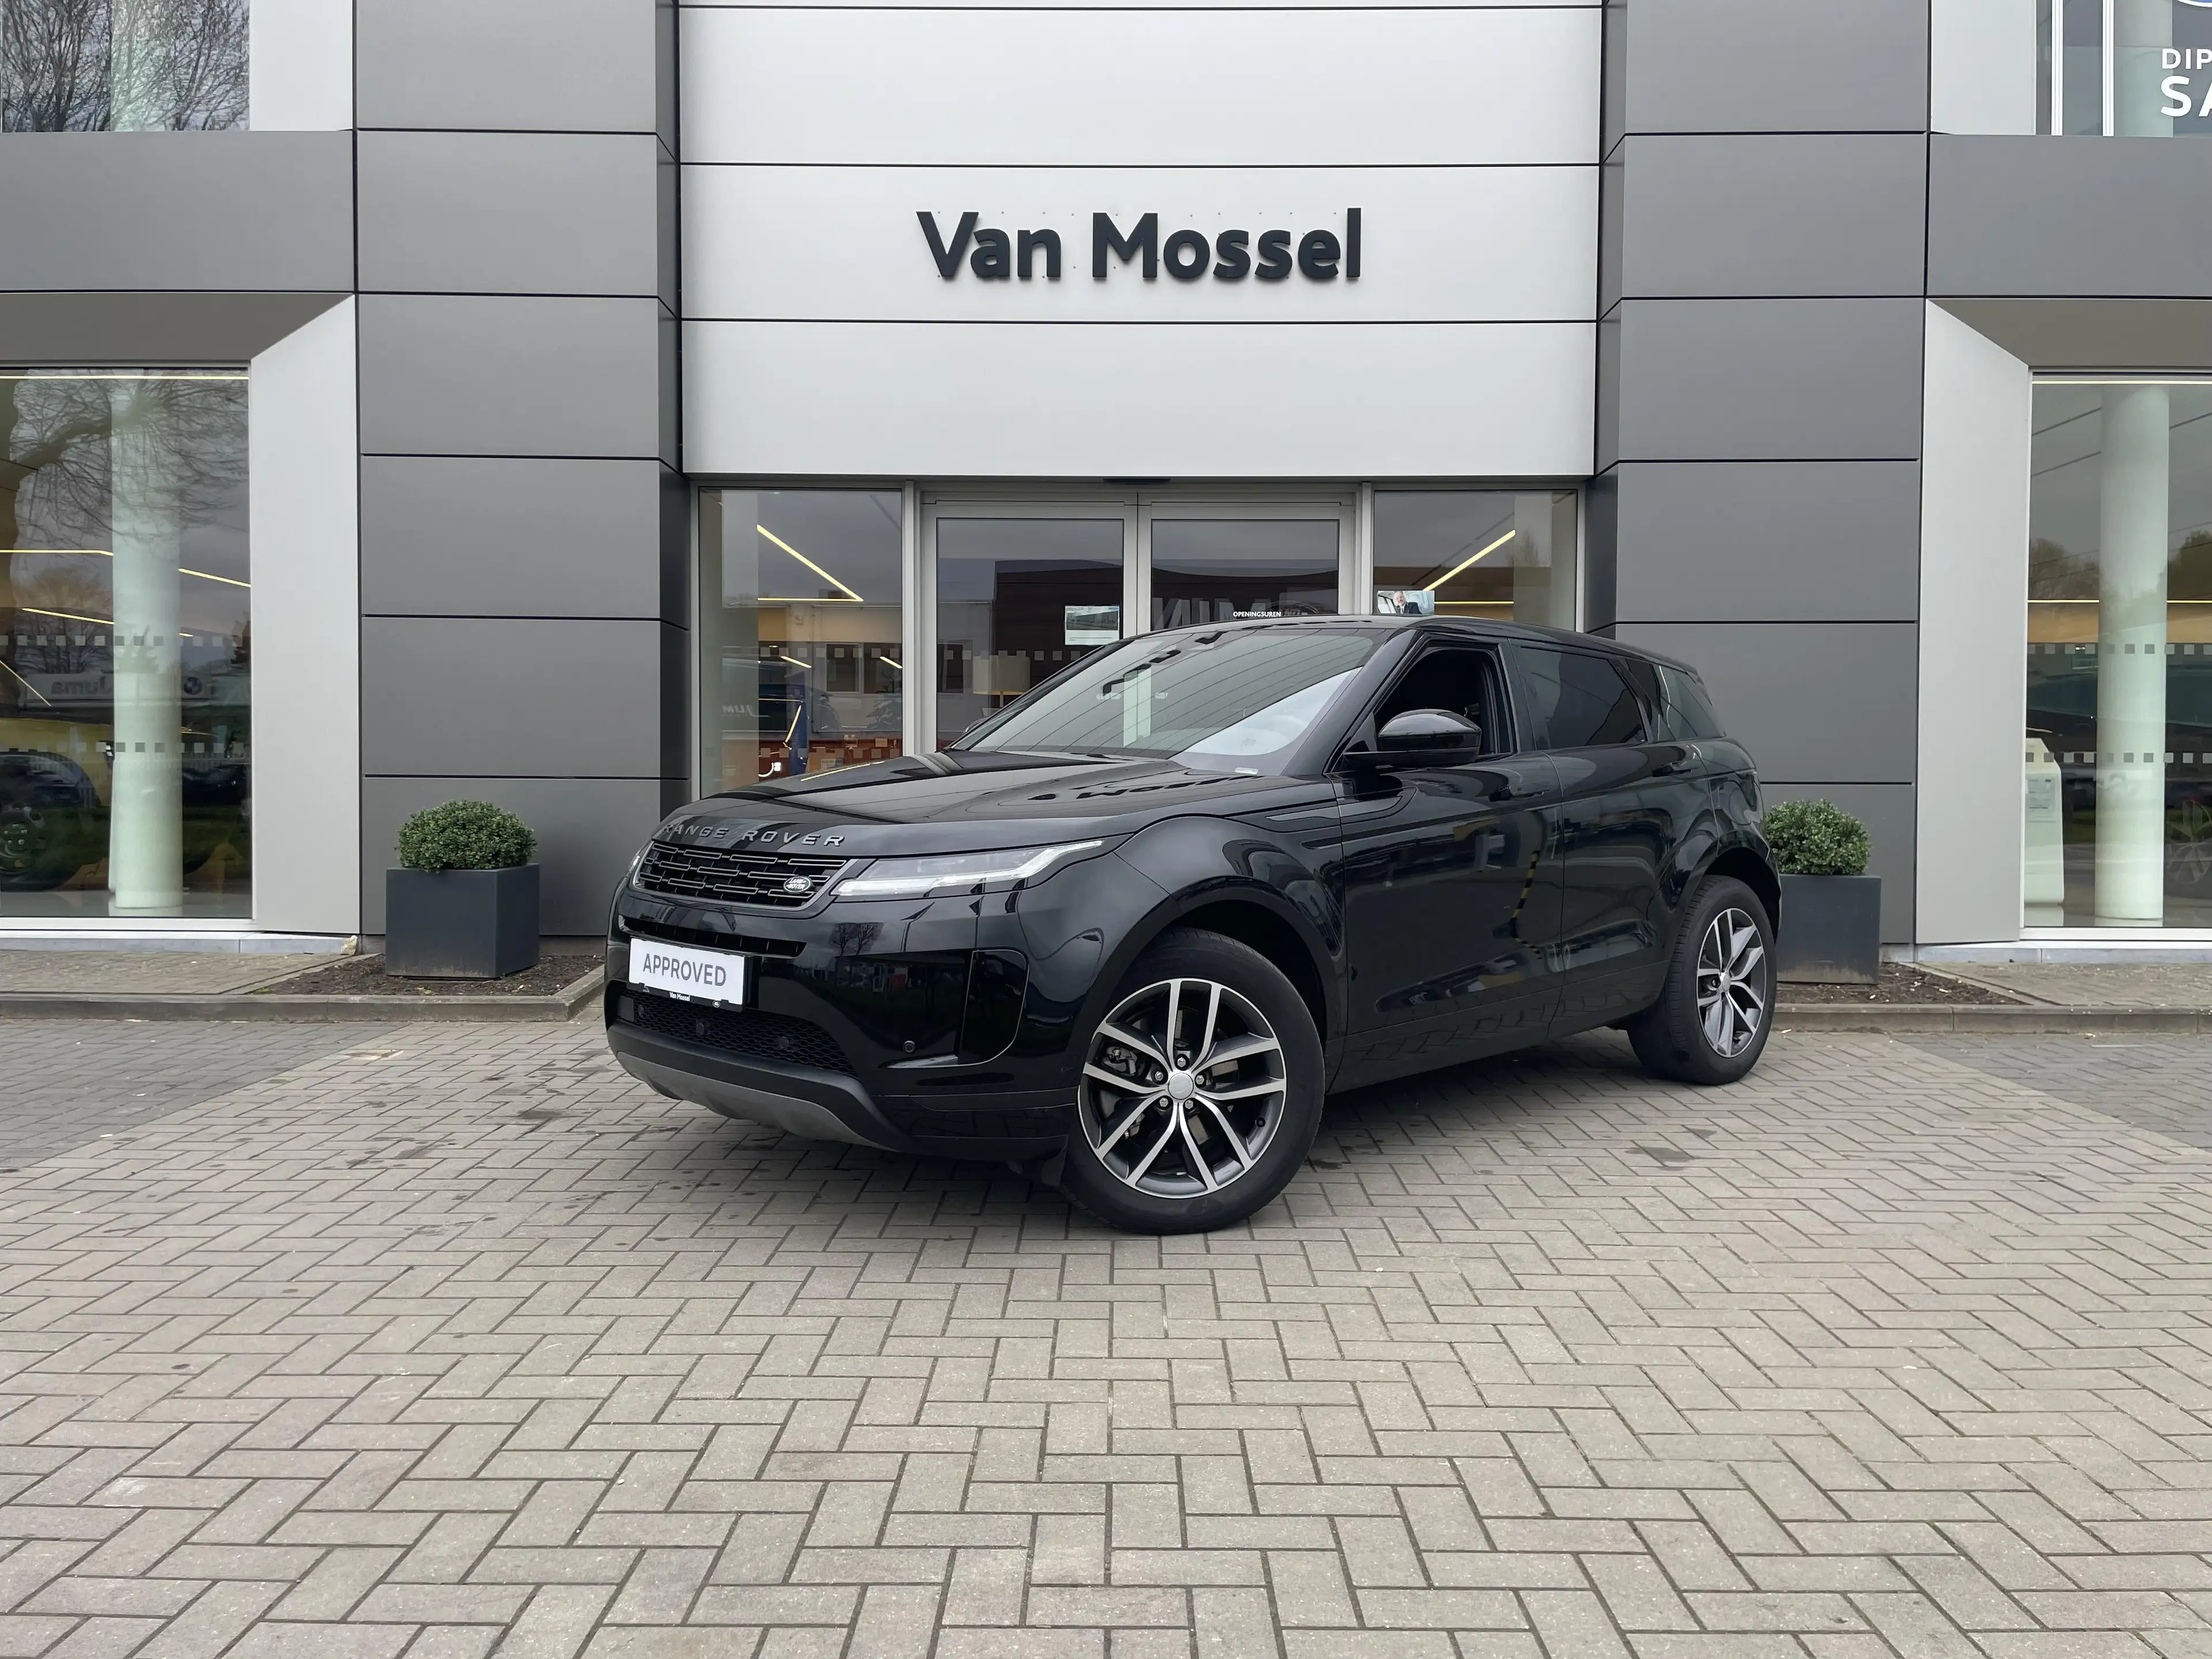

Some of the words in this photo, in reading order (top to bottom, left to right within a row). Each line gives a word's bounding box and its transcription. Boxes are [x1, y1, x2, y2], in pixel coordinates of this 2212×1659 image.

[915, 211, 1062, 281] Van
[1092, 207, 1362, 281] Mossel
[661, 824, 729, 839] RANGE
[741, 830, 845, 847] ROVER
[642, 953, 726, 987] APPROVED
